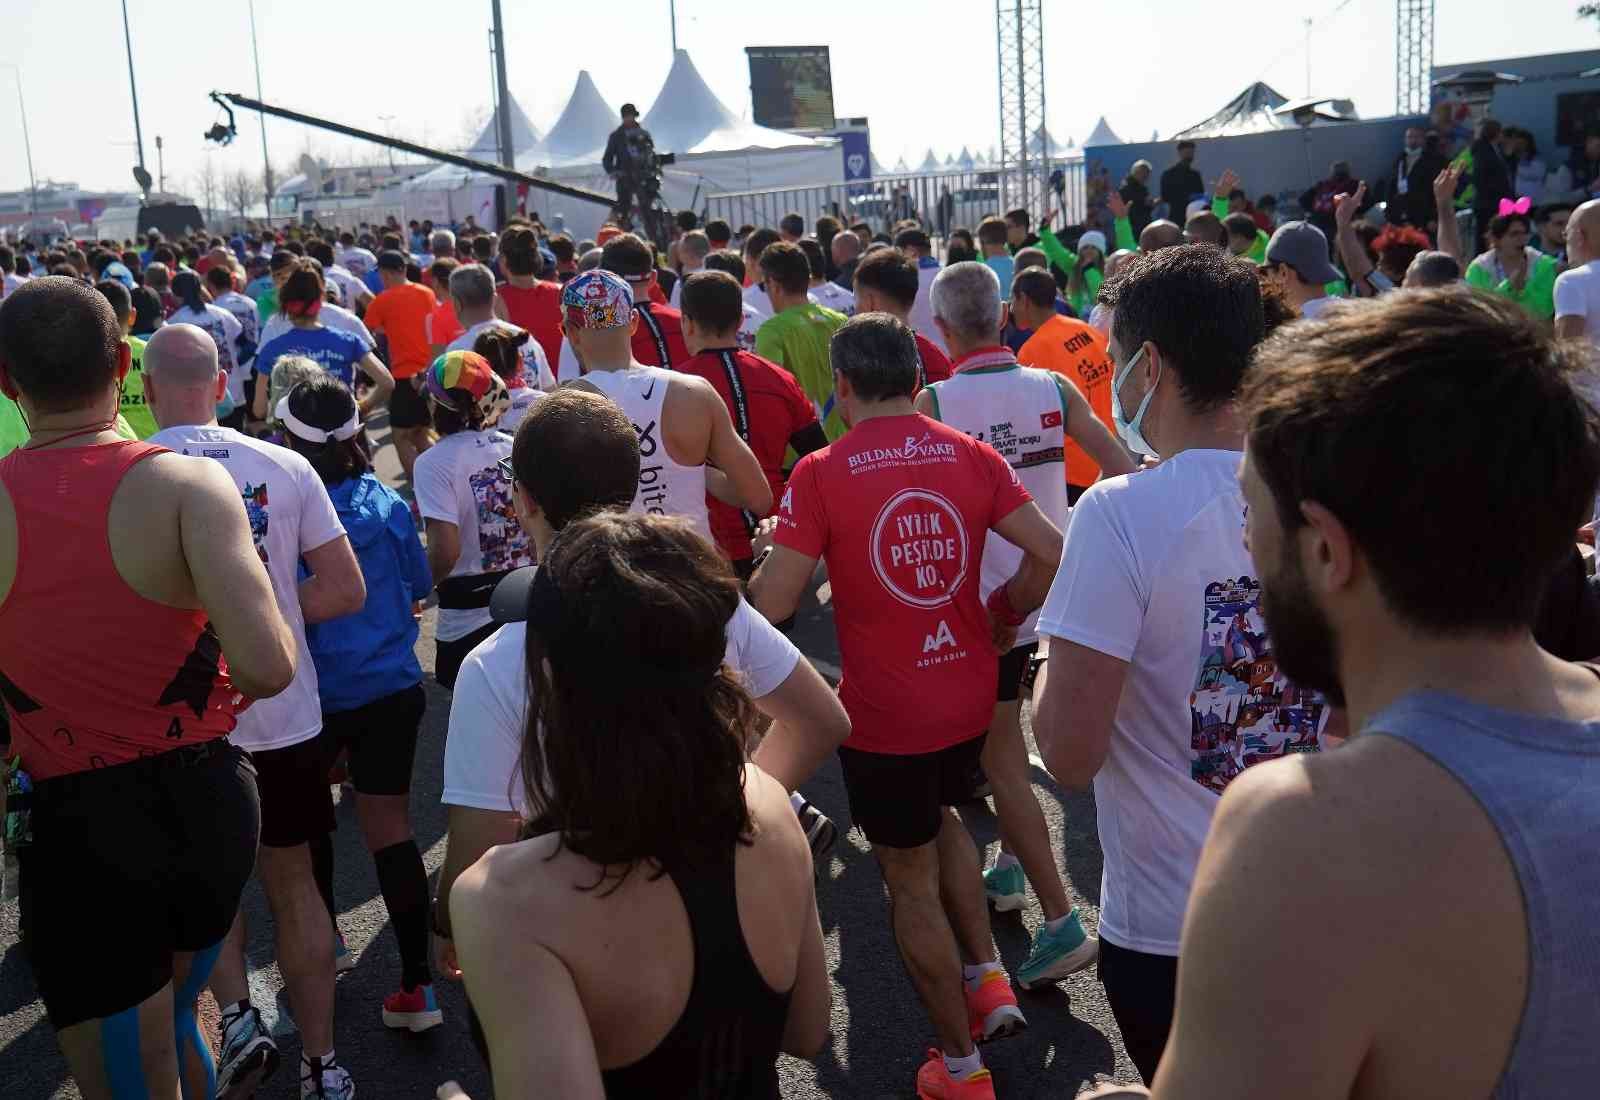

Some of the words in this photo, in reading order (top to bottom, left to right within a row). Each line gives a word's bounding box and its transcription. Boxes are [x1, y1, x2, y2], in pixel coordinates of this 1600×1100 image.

[848, 447, 902, 468] BULDAN
[919, 443, 956, 456] VAKFI
[915, 564, 945, 589] KO
[917, 656, 941, 668] ADIM
